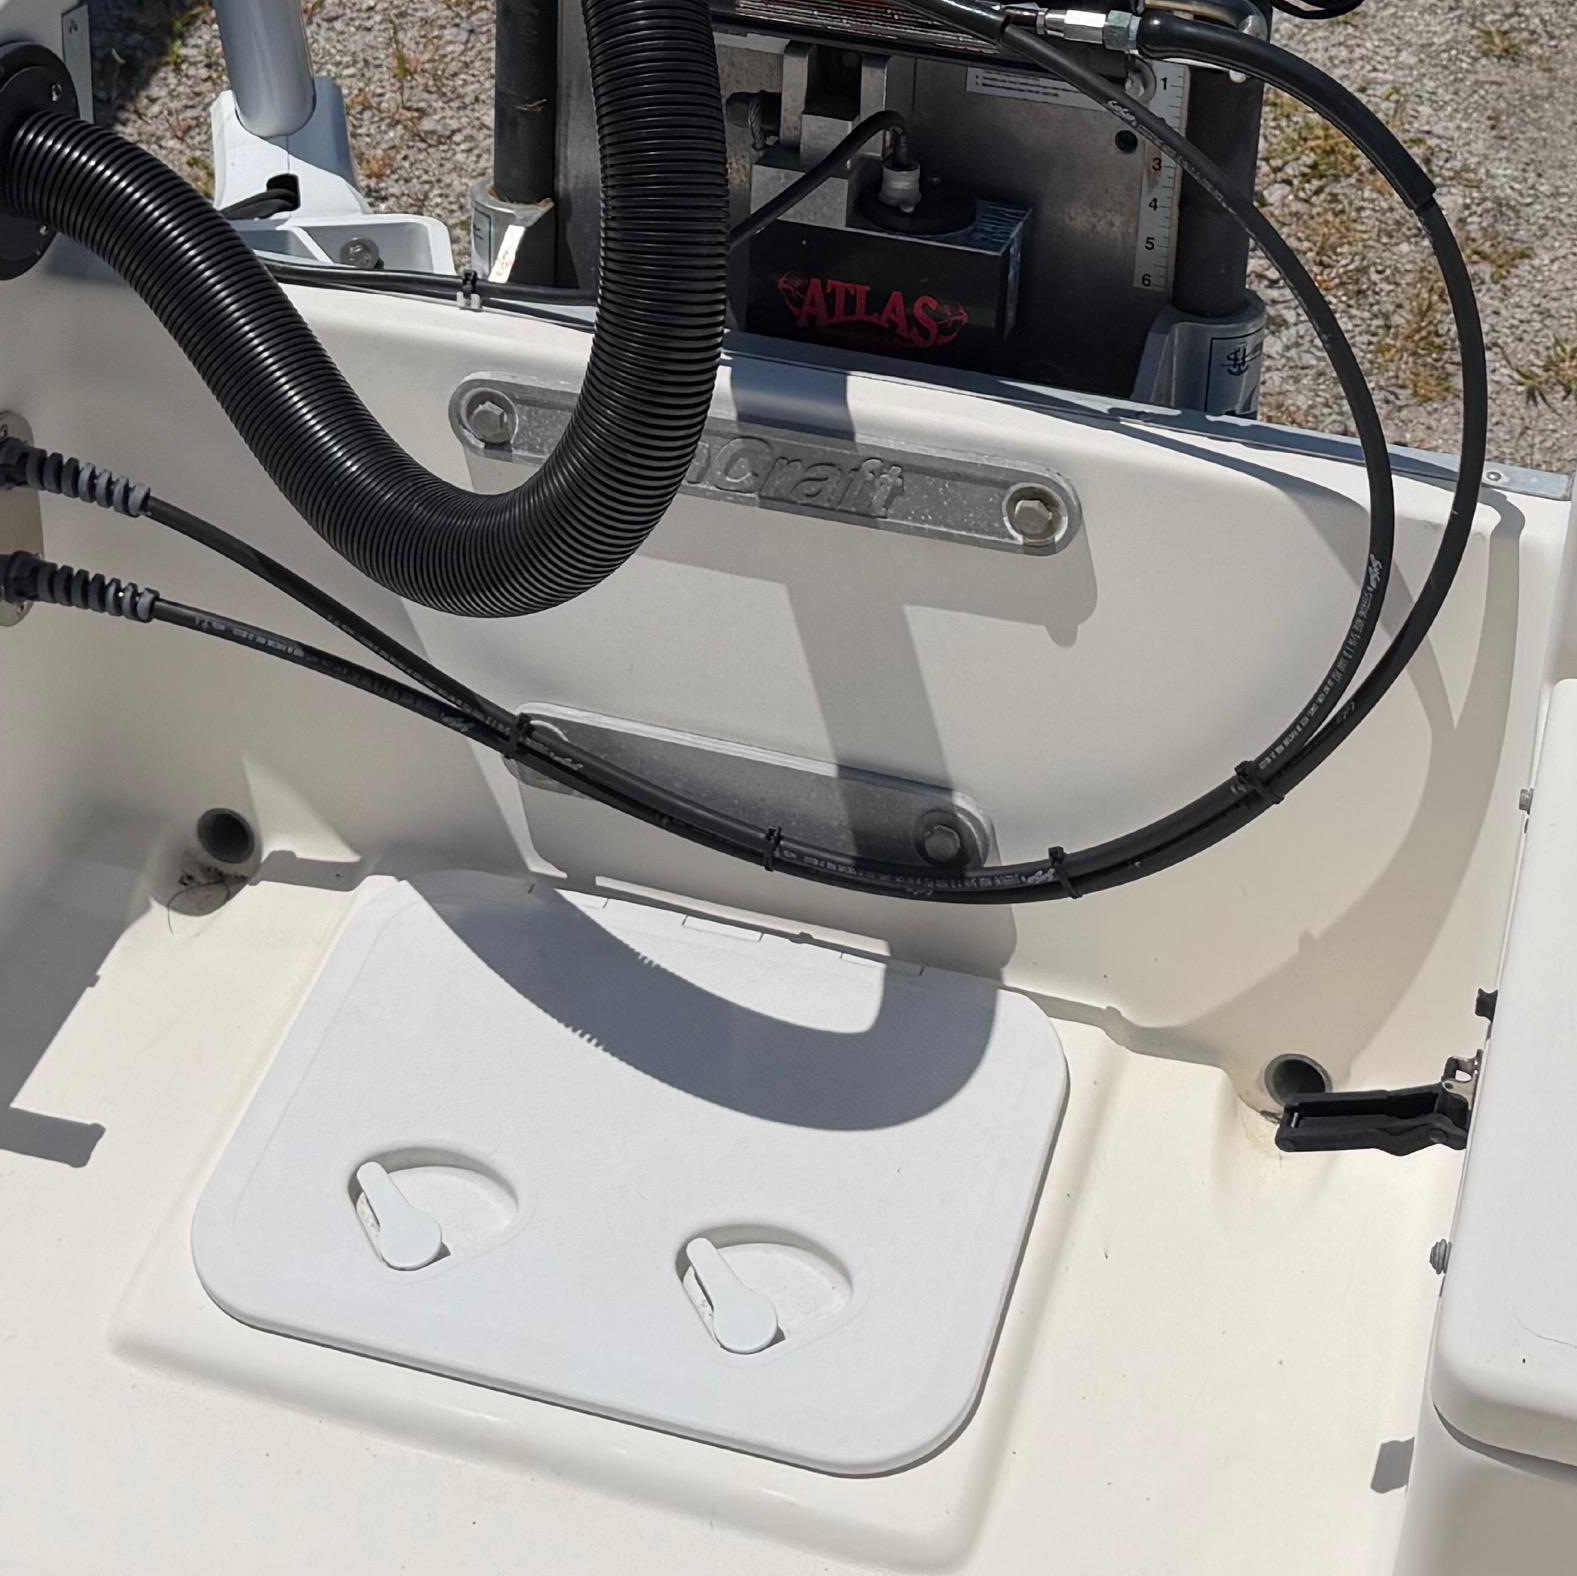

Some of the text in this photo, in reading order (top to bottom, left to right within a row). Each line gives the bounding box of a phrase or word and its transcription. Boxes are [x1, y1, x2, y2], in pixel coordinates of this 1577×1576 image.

[1161, 77, 1168, 91] 1
[1152, 159, 1162, 171] 3
[1148, 197, 1159, 212] 4
[1144, 237, 1155, 251] 5
[1141, 274, 1152, 288] 6
[798, 278, 940, 348] ATLAS
